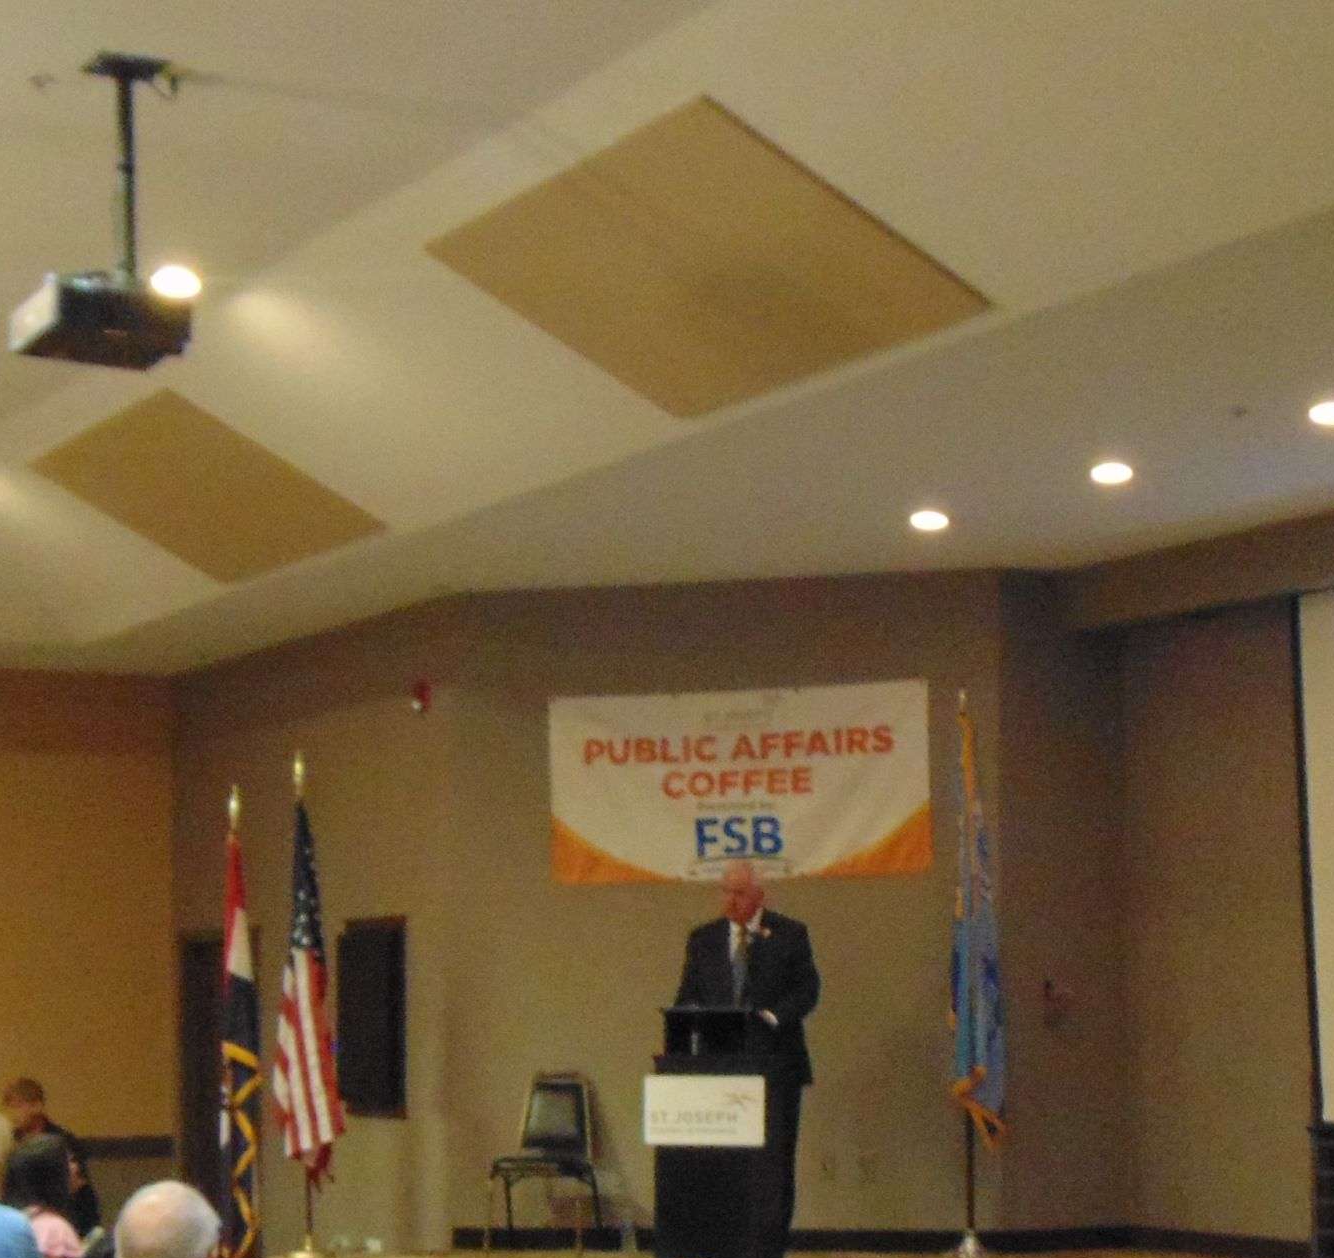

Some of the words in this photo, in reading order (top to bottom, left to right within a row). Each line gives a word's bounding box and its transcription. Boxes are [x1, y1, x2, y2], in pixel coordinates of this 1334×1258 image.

[585, 737, 717, 765] PUBLIC
[732, 726, 893, 760] AFFAIRS
[662, 768, 813, 799] COFFEE
[695, 815, 784, 857] FSB
[676, 1110, 738, 1124] JOSEPH
